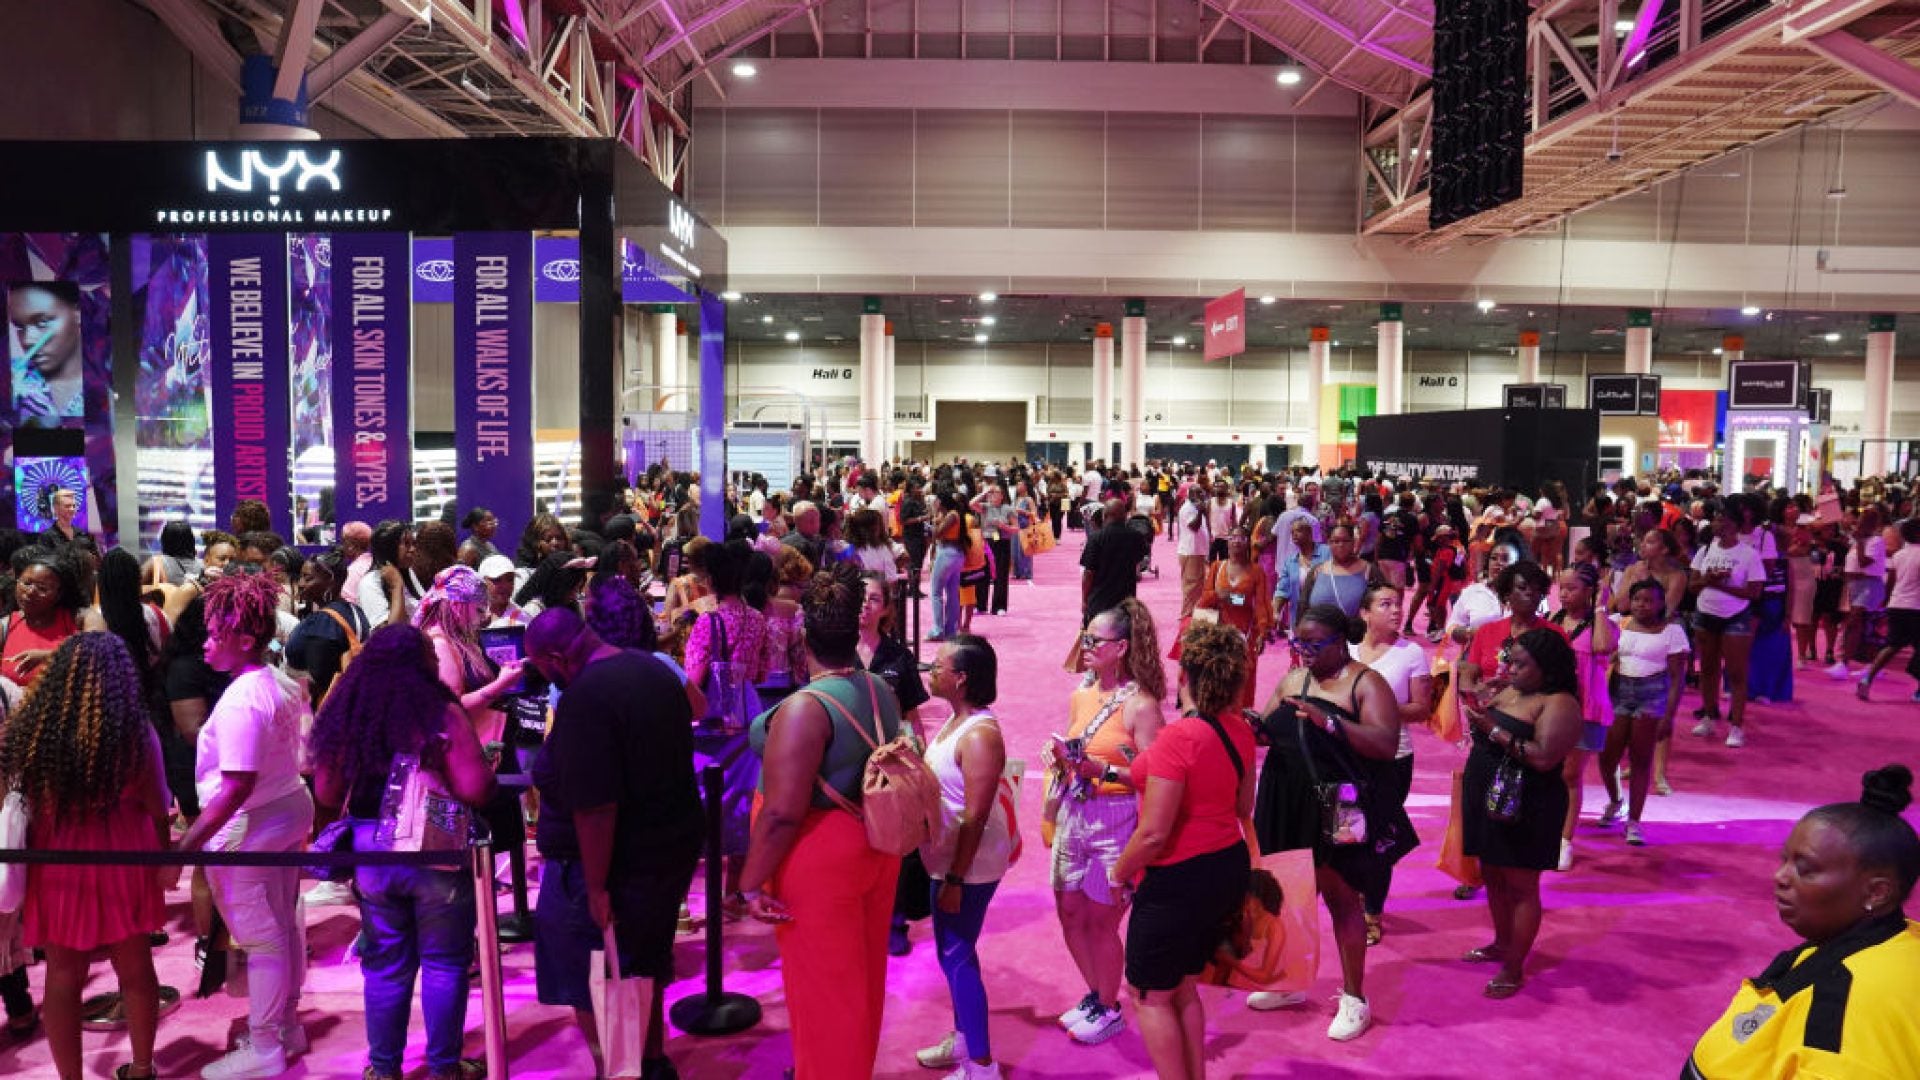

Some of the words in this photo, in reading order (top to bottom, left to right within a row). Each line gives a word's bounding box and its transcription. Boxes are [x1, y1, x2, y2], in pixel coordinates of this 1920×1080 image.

[206, 149, 342, 192] NYX
[157, 208, 304, 223] PROFESSIONAL
[314, 208, 392, 223] MAKEUP
[669, 199, 695, 250] NYX
[229, 257, 262, 288] WE
[352, 256, 385, 290] FOR
[475, 256, 509, 290] FOR
[230, 290, 263, 359] BELIEVE
[352, 293, 385, 326] ALL
[475, 293, 509, 326] ALL
[353, 328, 385, 370] SKIN
[475, 329, 509, 391] WALKS
[232, 362, 264, 380] IN
[812, 368, 839, 380] Hall
[842, 368, 852, 380] G
[1419, 376, 1445, 387] Hall
[232, 383, 266, 441] PROUD
[353, 373, 387, 428] TONES
[475, 395, 509, 417] OF
[355, 431, 387, 444] &
[476, 421, 509, 462] LIFE.
[356, 448, 387, 509] TYPES.
[1385, 462, 1424, 477] BEAUTY
[1425, 464, 1479, 481] MIXTAPE
